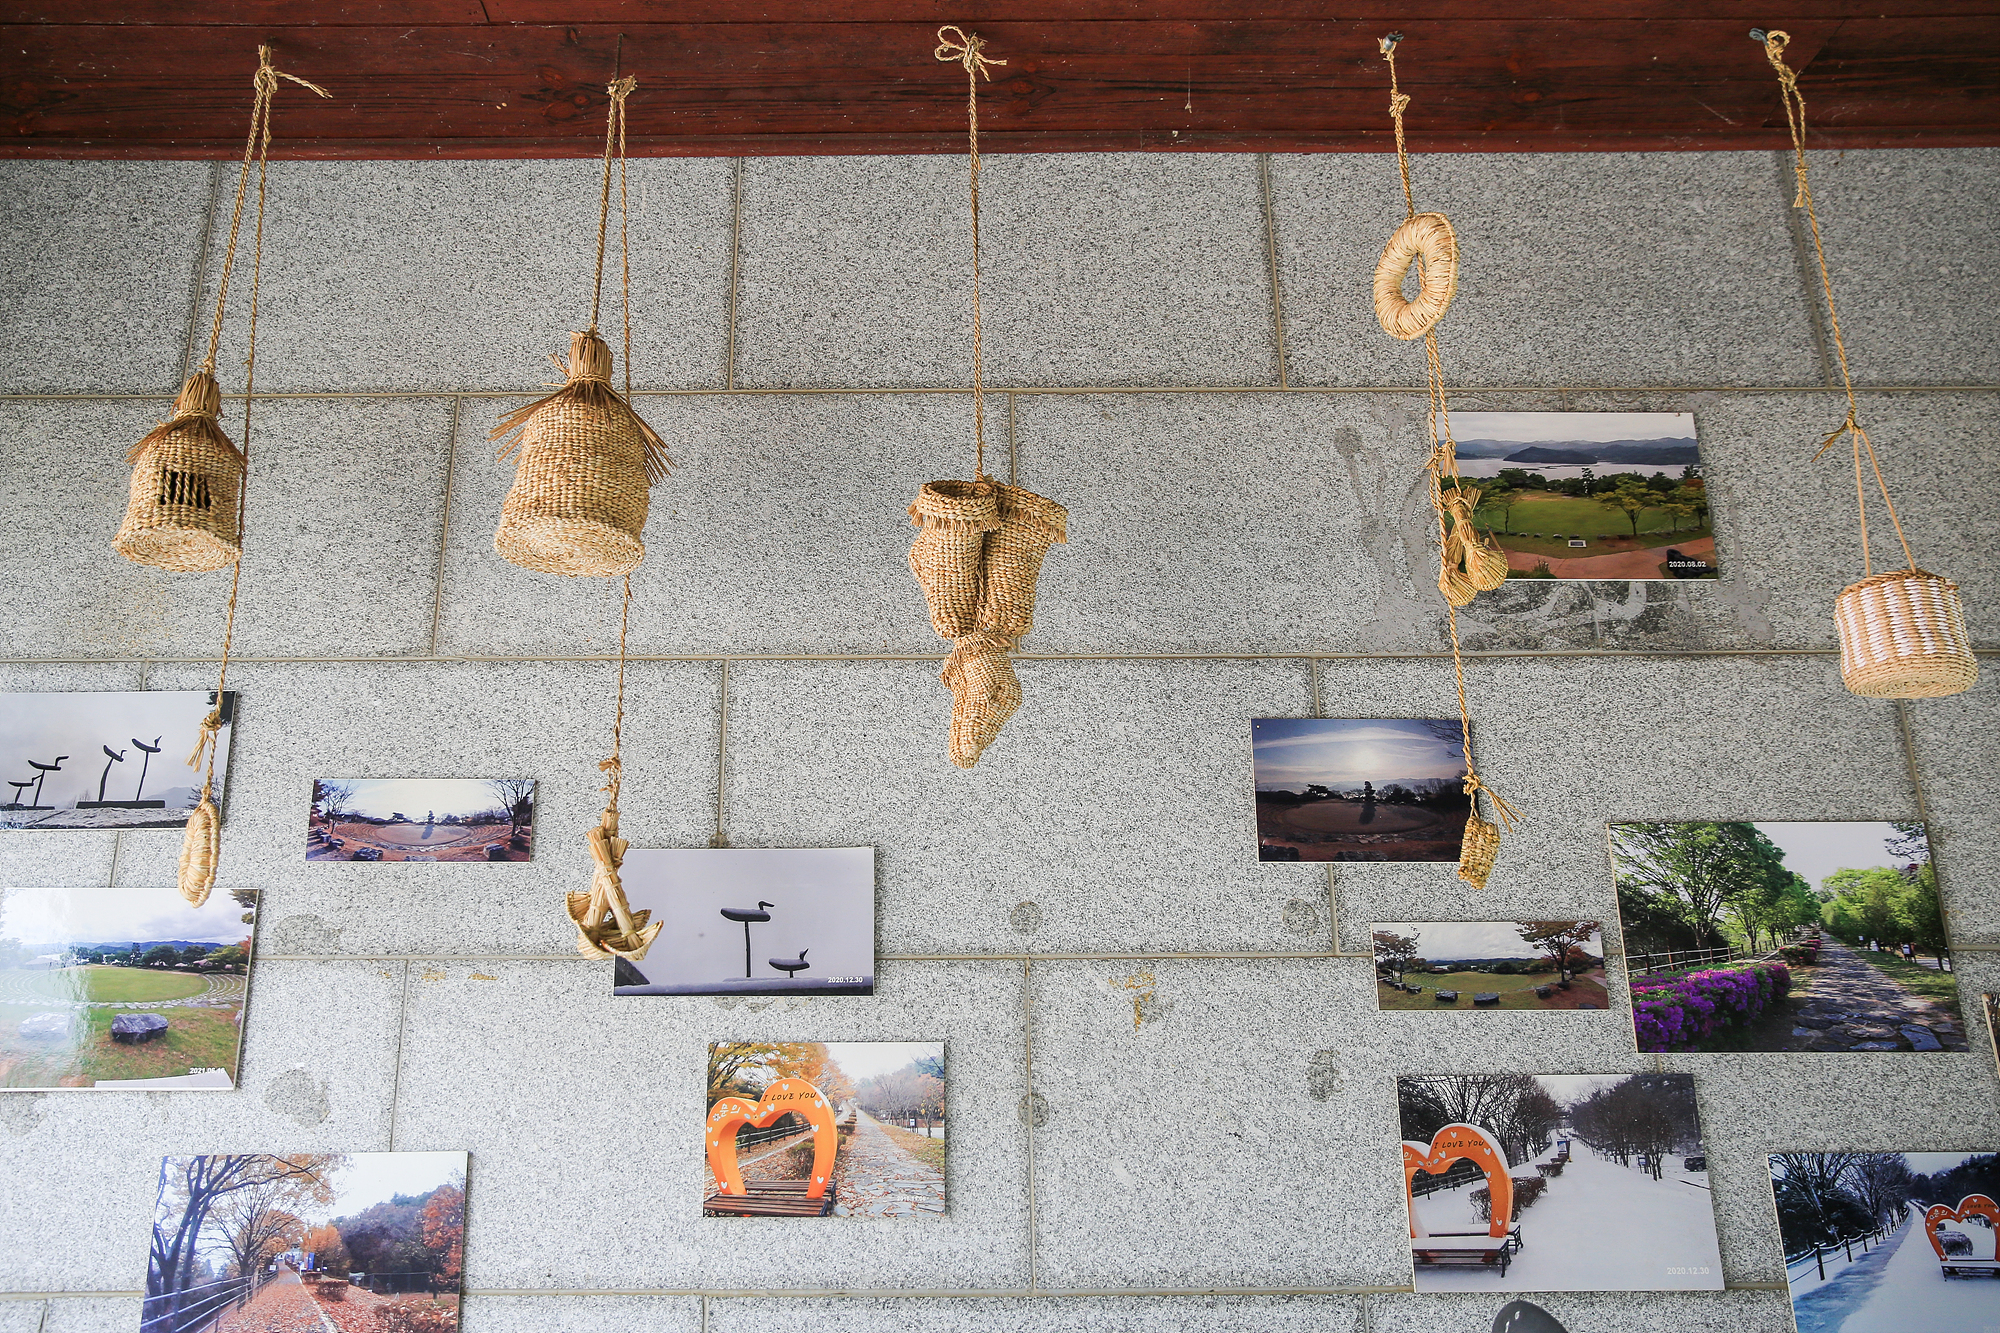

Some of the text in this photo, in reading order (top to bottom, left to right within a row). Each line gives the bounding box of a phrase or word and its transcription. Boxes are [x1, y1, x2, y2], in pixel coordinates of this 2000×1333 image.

[763, 1091, 818, 1102] I LOVE YOU
[1441, 1140, 1464, 1149] LOVE
[1467, 1139, 1485, 1148] YOU
[1666, 1266, 1710, 1275] 2020.12.30
